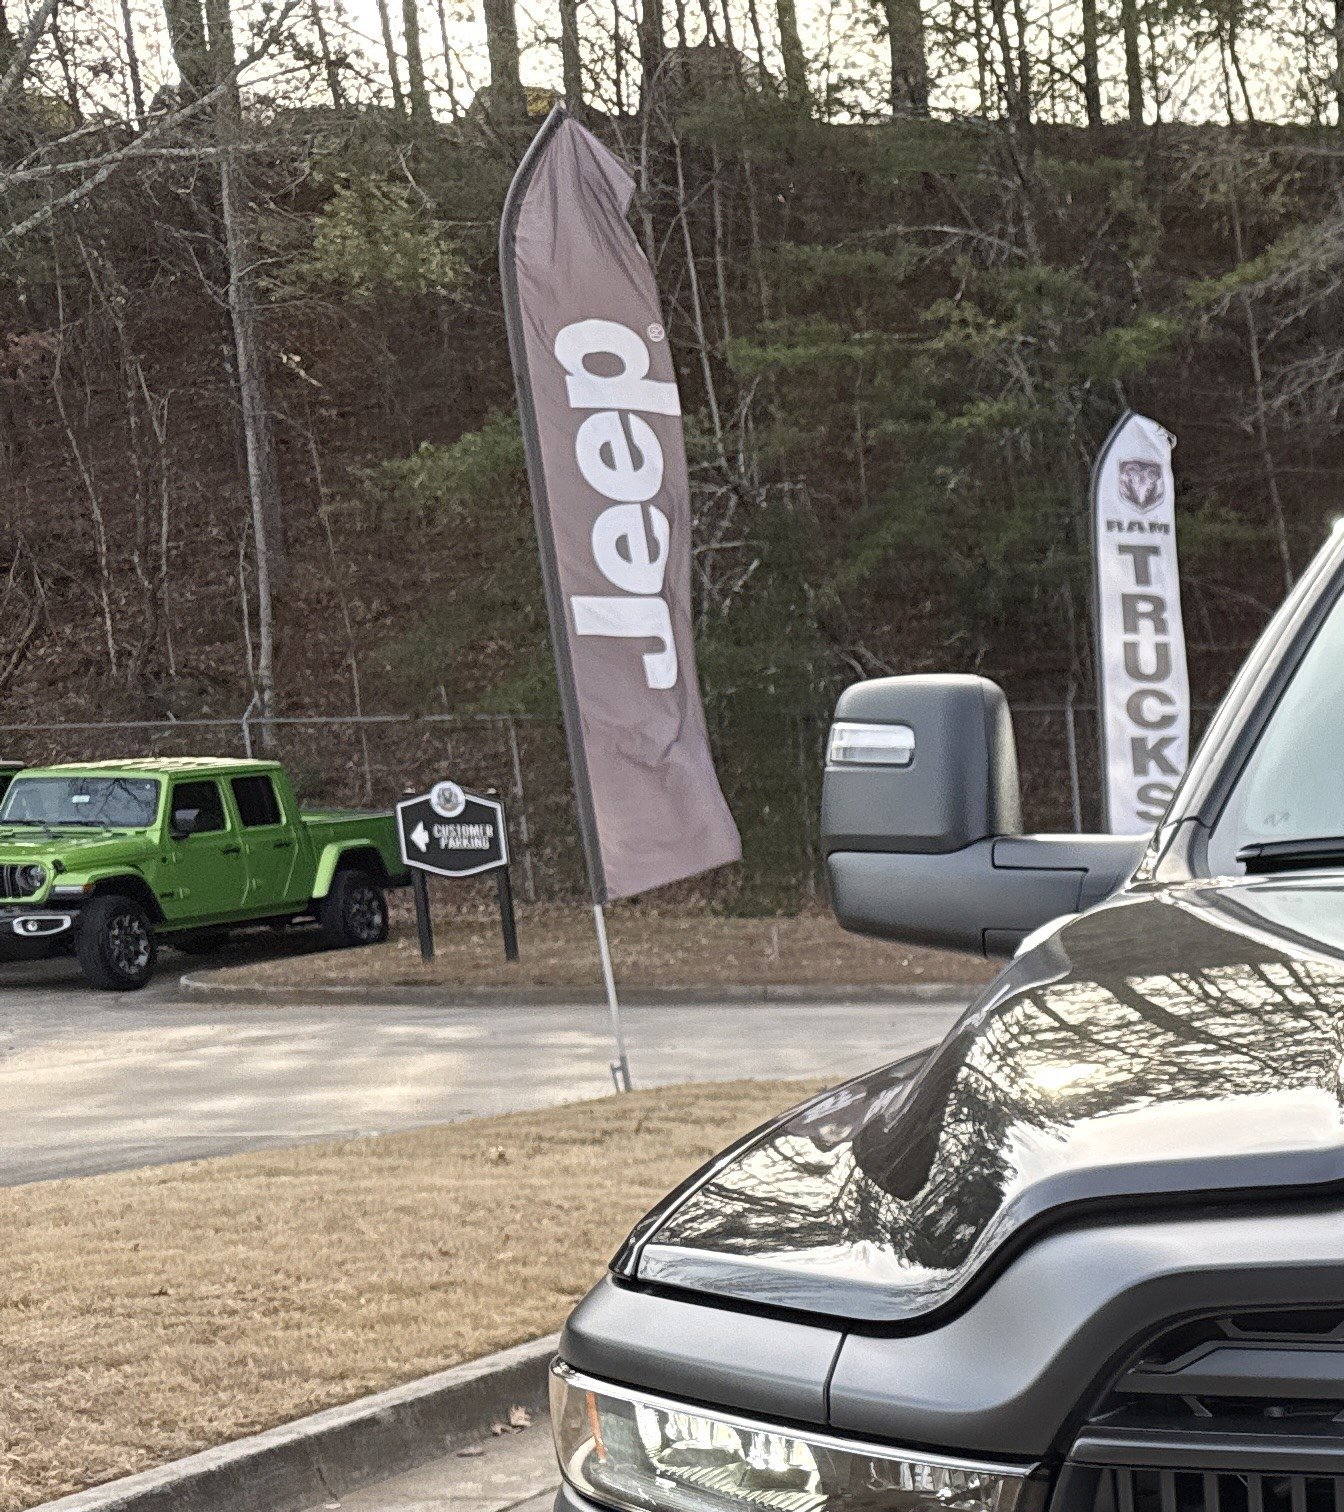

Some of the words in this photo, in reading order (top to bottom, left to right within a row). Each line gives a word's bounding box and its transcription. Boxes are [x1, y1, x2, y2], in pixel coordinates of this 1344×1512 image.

[554, 318, 681, 690] Jeep
[1106, 519, 1171, 536] RAM
[1117, 544, 1181, 824] TRUCKS
[433, 823, 494, 838] CUSTOMER
[440, 838, 490, 850] PARKING
